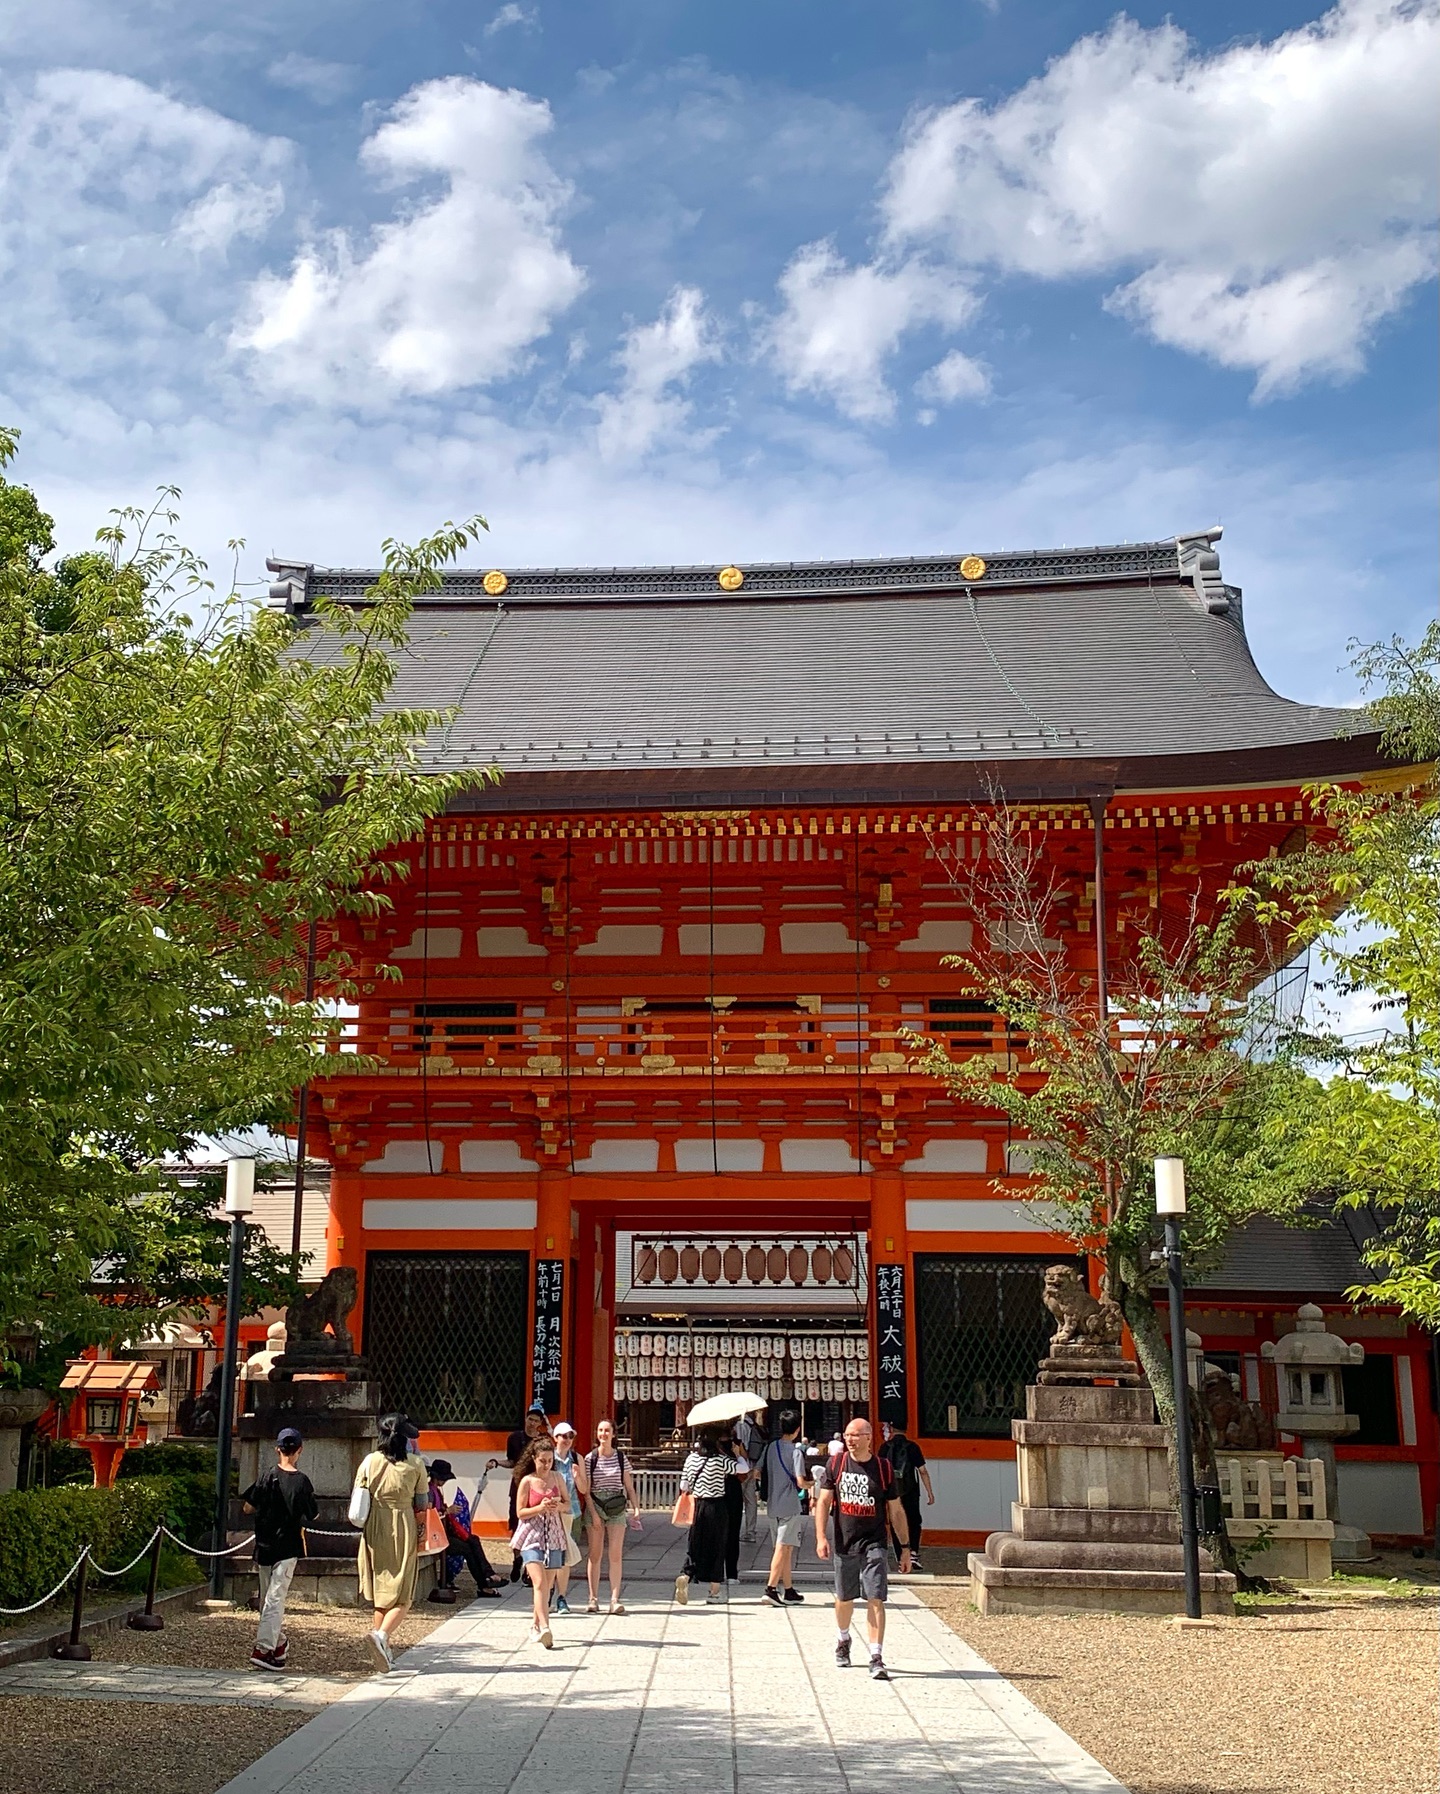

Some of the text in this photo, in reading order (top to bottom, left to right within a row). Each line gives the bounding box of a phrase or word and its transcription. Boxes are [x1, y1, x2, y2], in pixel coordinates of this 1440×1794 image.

[536, 1262, 549, 1309] 午前十時
[878, 1267, 890, 1311] 午後三時
[891, 1266, 903, 1318] 六月三十日
[547, 1262, 562, 1381] 七月一日 月次祭並
[879, 1324, 905, 1399] 大祓式
[839, 1481, 869, 1496] KYOTO
[840, 1493, 875, 1506] SAPPORO
[841, 1471, 869, 1485] TOKYO
[841, 1502, 876, 1516] OKINAWA
